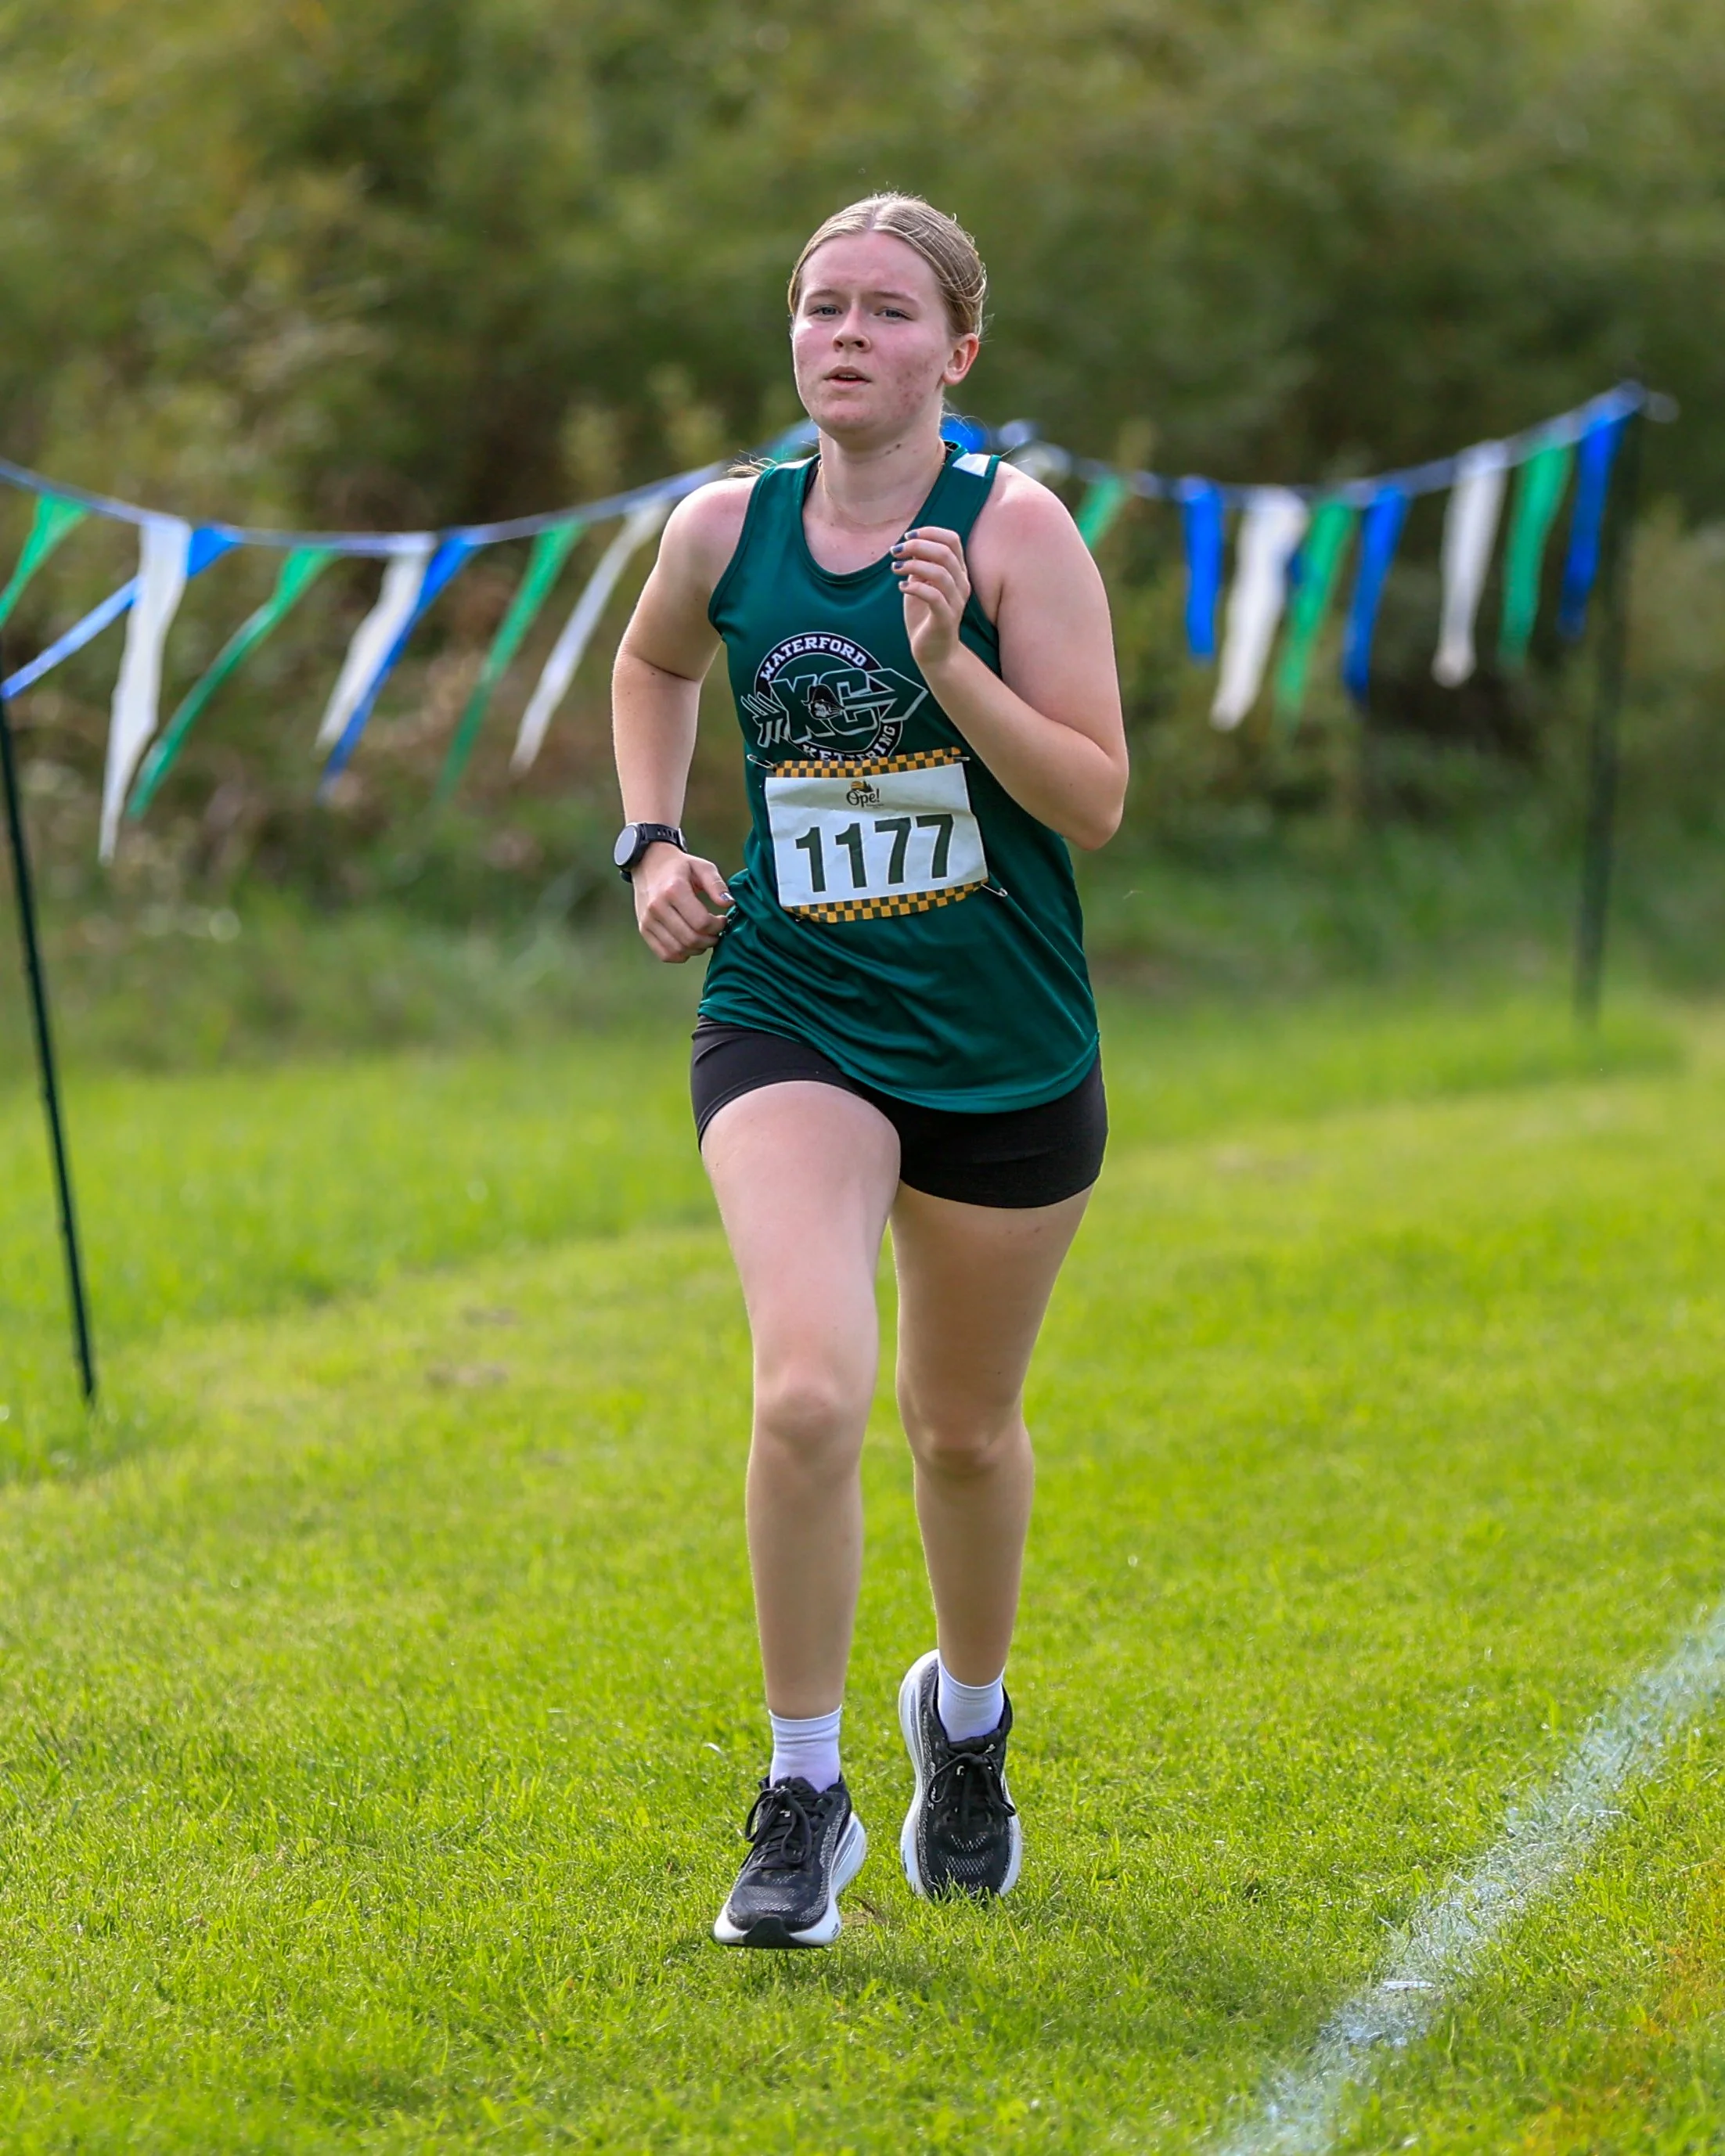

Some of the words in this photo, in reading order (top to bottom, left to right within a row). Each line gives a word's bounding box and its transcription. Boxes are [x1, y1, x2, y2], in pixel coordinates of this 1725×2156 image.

[759, 636, 867, 682] WATERFORD
[846, 787, 880, 808] Ope!
[795, 814, 954, 893] 1177
